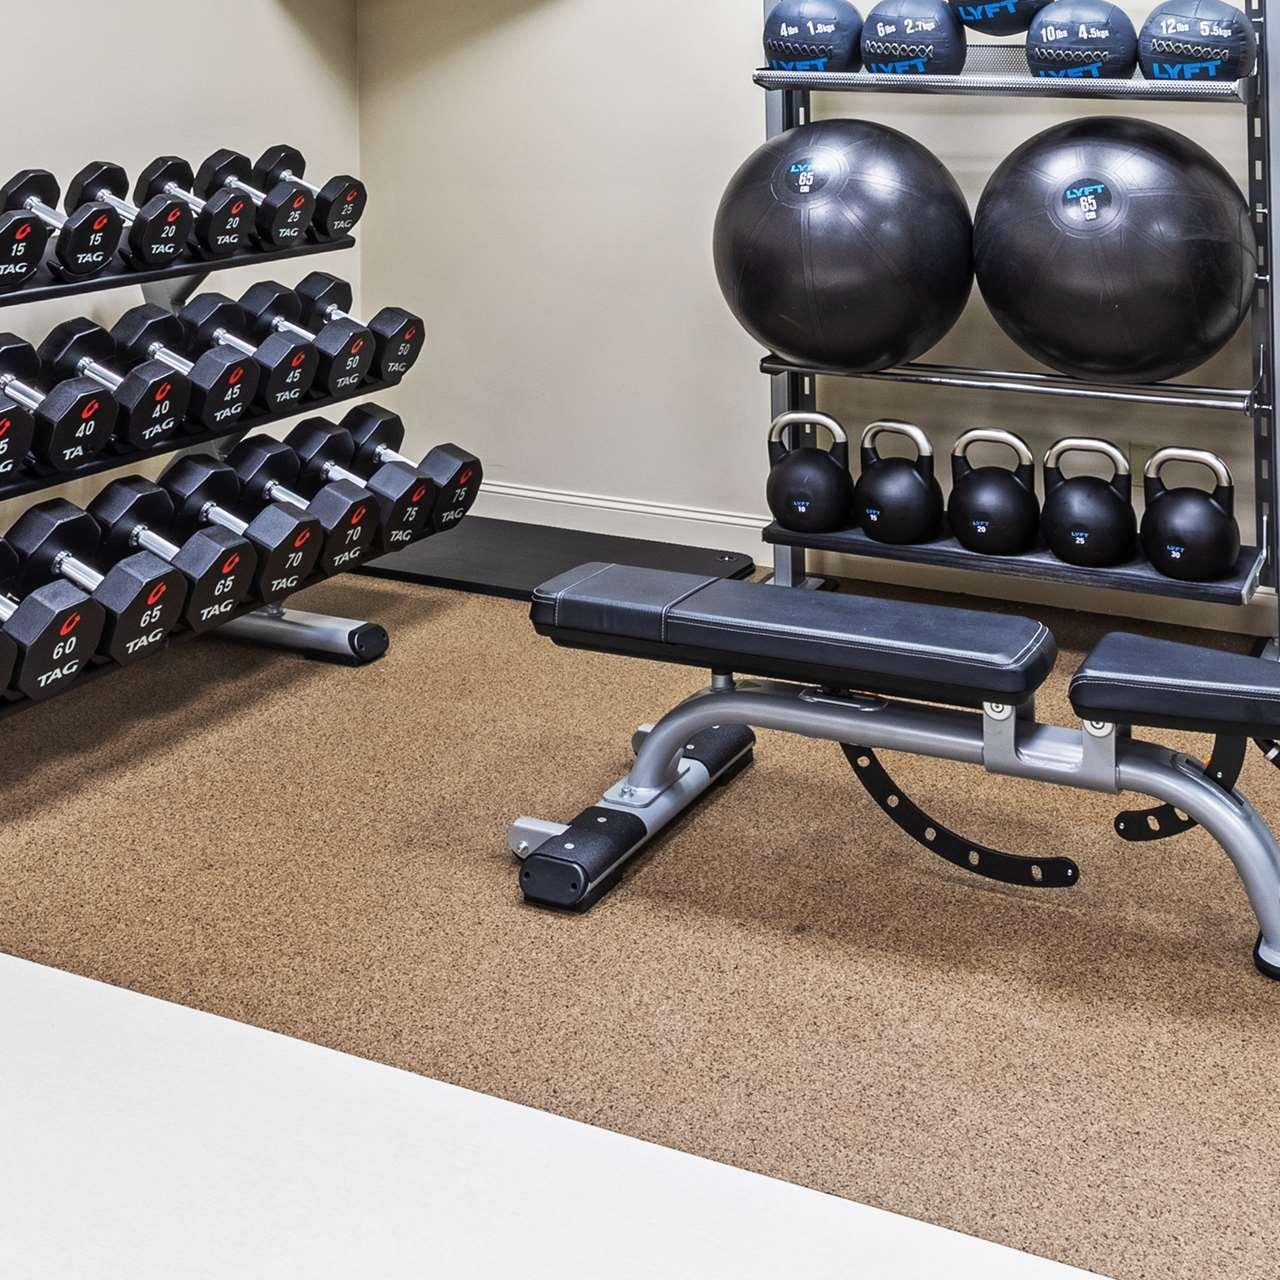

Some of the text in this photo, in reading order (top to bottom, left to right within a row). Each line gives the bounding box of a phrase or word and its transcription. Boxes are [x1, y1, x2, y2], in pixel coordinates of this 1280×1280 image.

[771, 56, 831, 71] LYFT
[870, 56, 928, 73] LYFT
[1152, 59, 1224, 79] LYFT
[799, 172, 814, 185] 65
[1066, 184, 1105, 199] LYFT
[287, 210, 302, 223] 25
[340, 203, 354, 215] 25
[225, 216, 240, 230] 20
[333, 219, 353, 232] TAG
[89, 232, 103, 246] 15
[160, 225, 176, 238] 20
[216, 233, 239, 245] TAG
[279, 227, 299, 238] TAG
[11, 242, 26, 257] 15
[151, 243, 175, 254] TAG
[76, 251, 105, 264] TAG
[397, 343, 411, 356] 50
[345, 355, 360, 370] 50
[387, 362, 408, 374] TAG
[285, 368, 302, 384] 45
[336, 373, 360, 388] TAG
[223, 384, 241, 401] 45
[275, 388, 301, 403] TAG
[152, 401, 169, 419] 40
[214, 403, 242, 421] TAG
[76, 421, 94, 437] 40
[143, 418, 174, 439] TAG
[452, 487, 468, 503] 75
[402, 506, 418, 522] 75
[441, 507, 465, 523] TAG
[346, 527, 361, 544] 70
[390, 529, 413, 542] TAG
[286, 552, 302, 568] 70
[333, 547, 360, 566] TAG
[215, 576, 234, 595] 65
[271, 575, 299, 592] TAG
[141, 605, 162, 628] 65
[201, 600, 233, 620] TAG
[53, 637, 77, 660] 60
[126, 628, 163, 653] TAG
[37, 659, 79, 687] TAG
